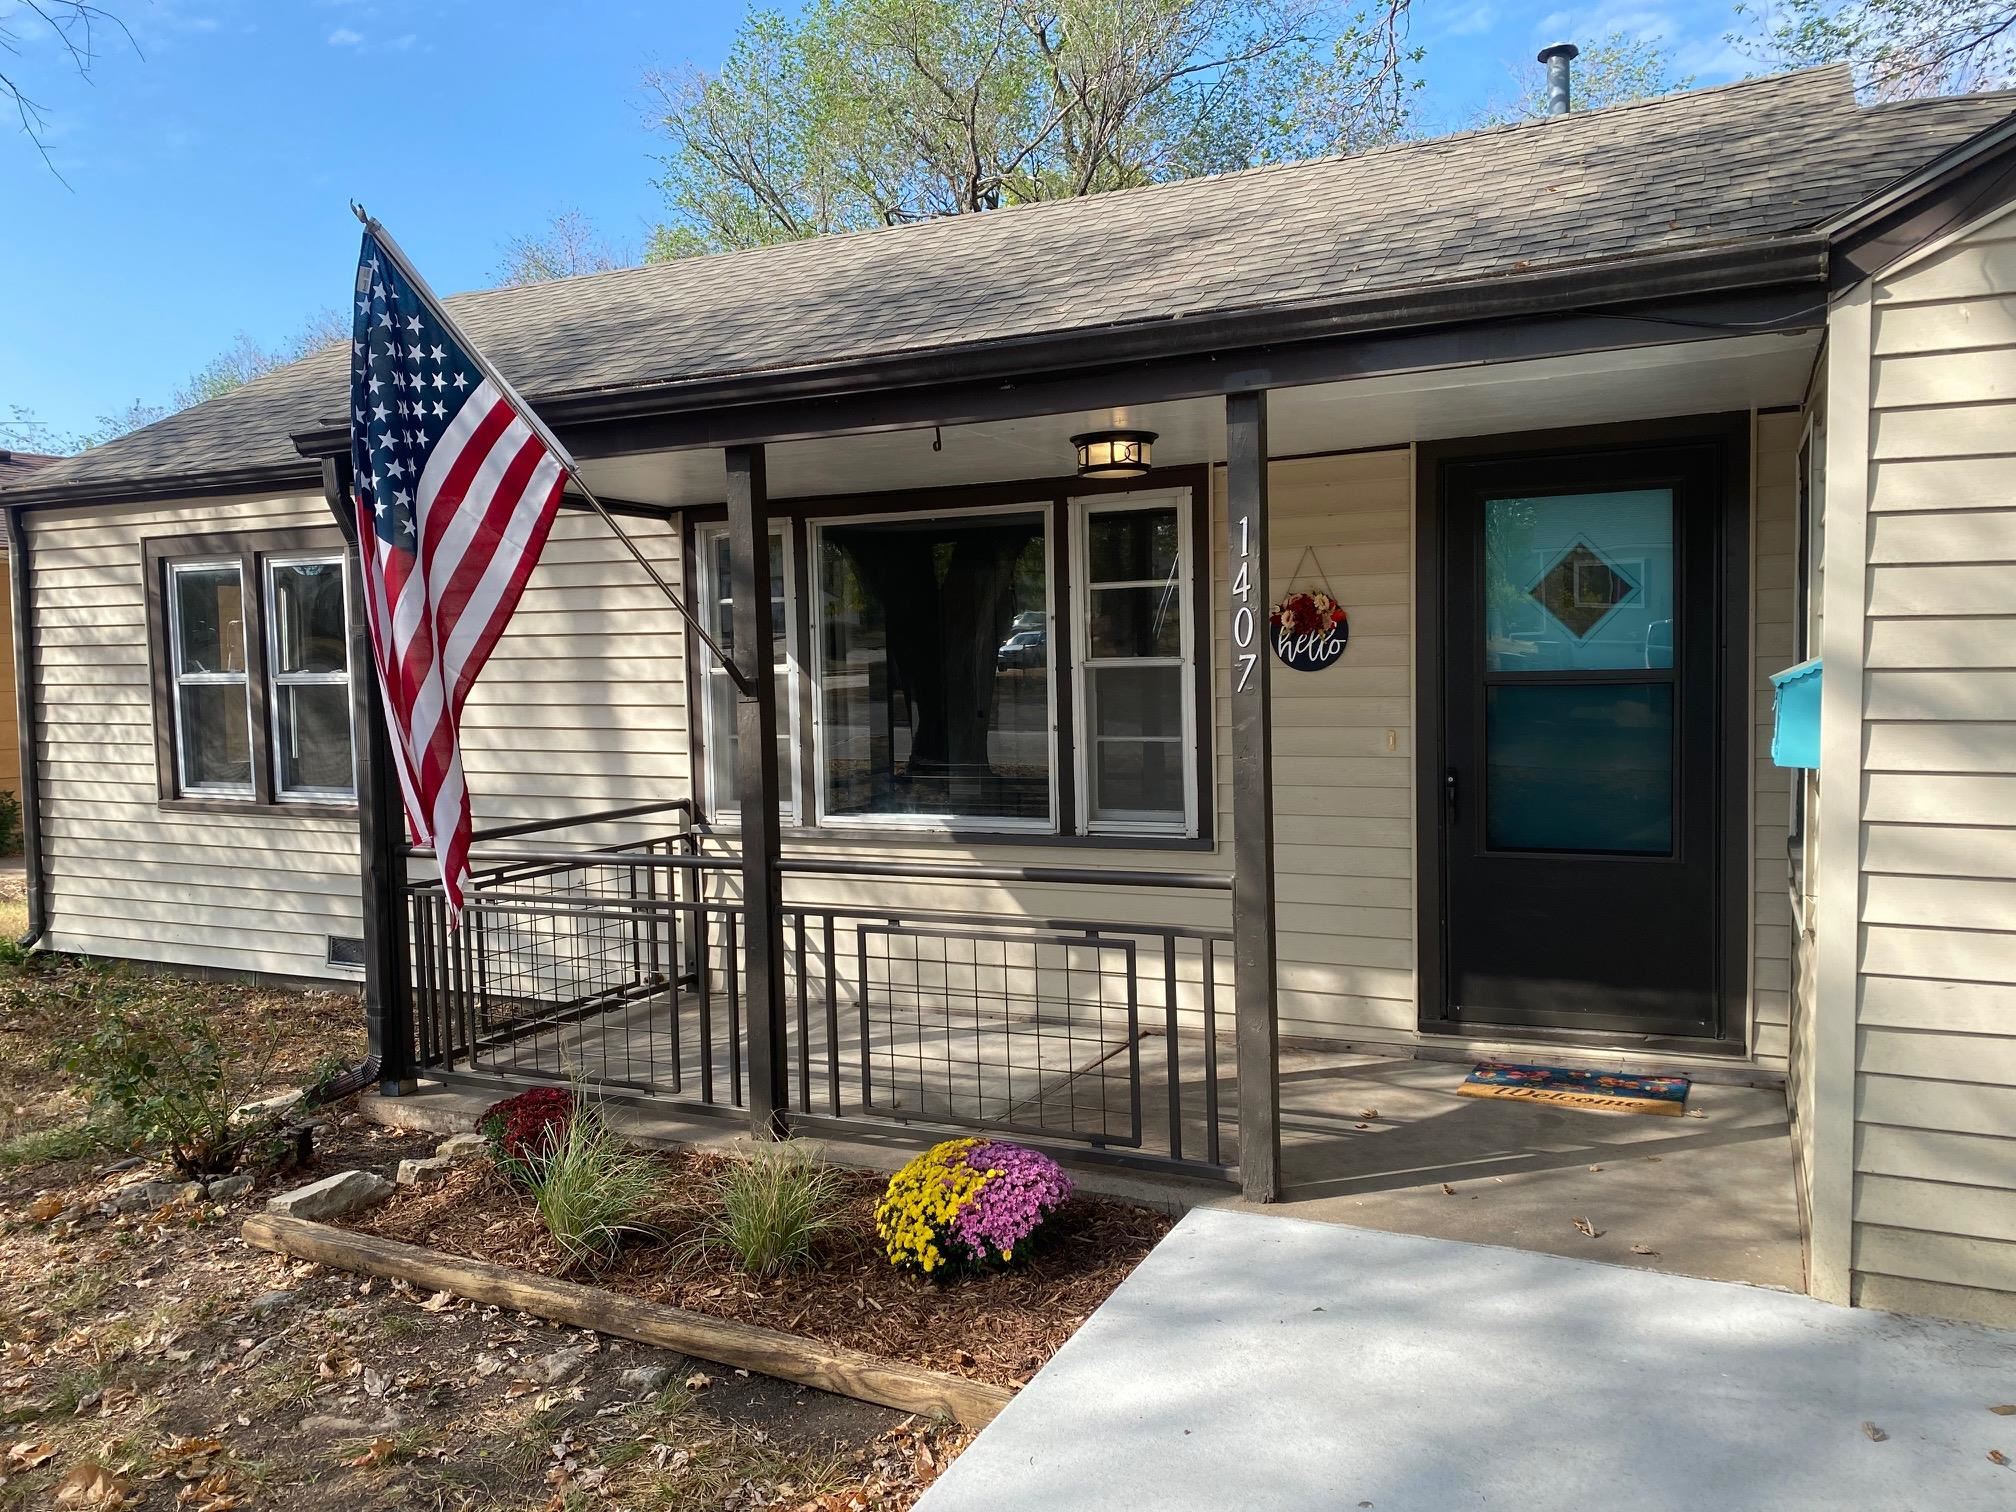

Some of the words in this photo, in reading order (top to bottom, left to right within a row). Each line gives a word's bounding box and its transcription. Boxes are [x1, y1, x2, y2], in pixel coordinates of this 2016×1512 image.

[1232, 516, 1258, 693] 1407
[1277, 621, 1346, 663] hello
[1492, 1086, 1647, 1108] Welcome
